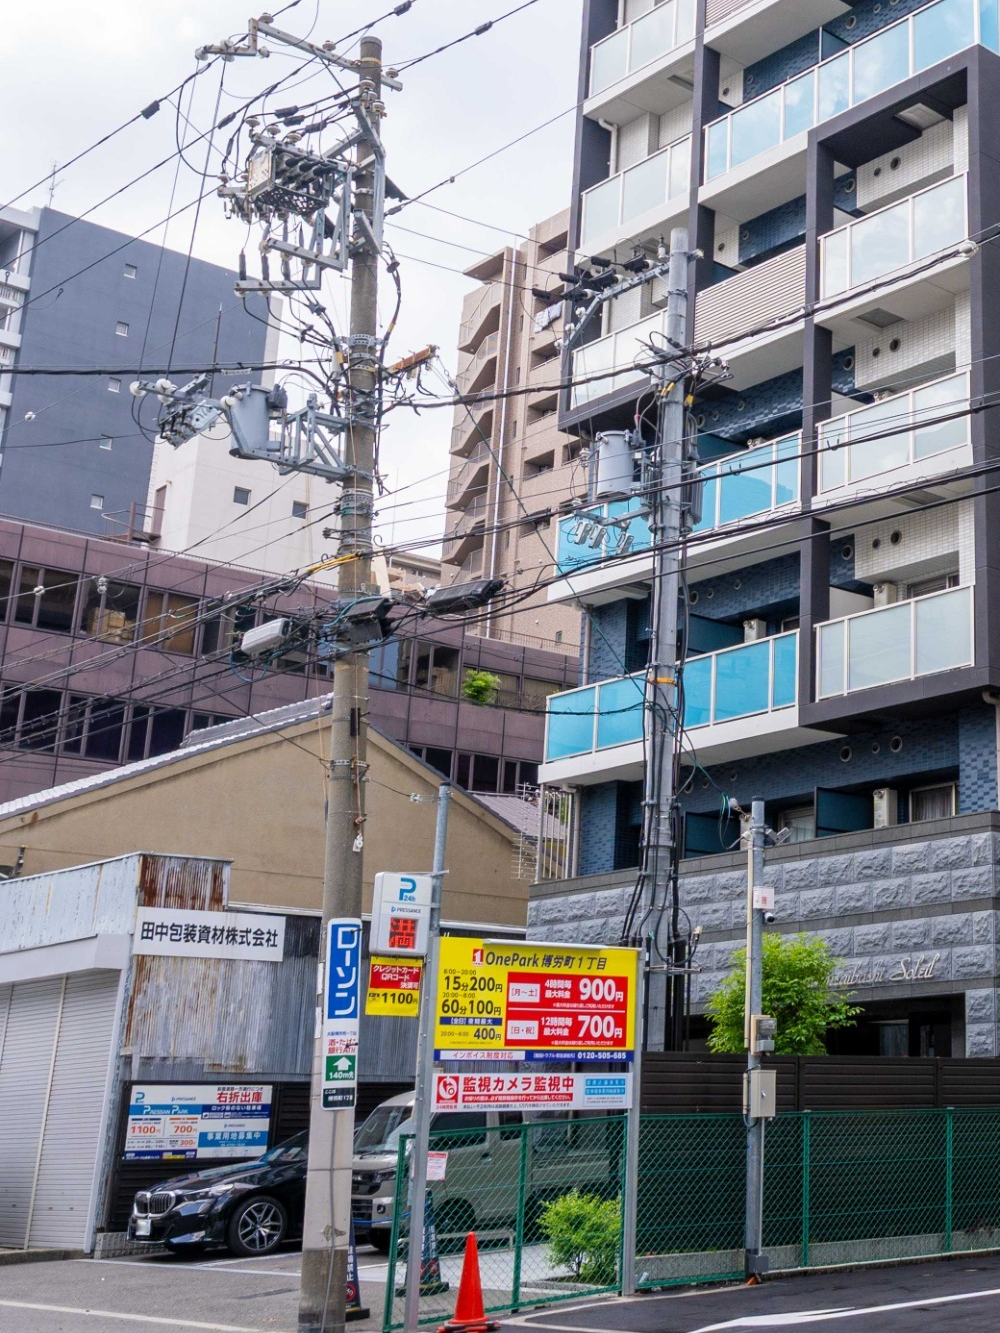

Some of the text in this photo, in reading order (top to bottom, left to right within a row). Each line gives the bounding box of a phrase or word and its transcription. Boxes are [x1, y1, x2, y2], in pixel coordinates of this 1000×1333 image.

[403, 894, 416, 902] 24h
[140, 921, 279, 948] 田中包装資材株式会社
[388, 917, 416, 949] 満
[485, 951, 539, 968] OnePark
[334, 927, 358, 1016] ローソン
[372, 965, 419, 975] クレジットカード
[889, 953, 940, 981] Soleil
[381, 973, 410, 982] QRコード
[544, 979, 572, 989] 4時間毎
[544, 990, 571, 999] 最大料金
[579, 978, 624, 1002] 900円
[541, 1016, 573, 1027] 12時間毎
[577, 1015, 623, 1039] 700円
[473, 1027, 502, 1041] 400円
[543, 1027, 570, 1037] 最大料金
[453, 1050, 514, 1060] インボイス制度対応
[577, 1051, 627, 1060] 0120-505-685
[328, 1071, 354, 1080] 140m先
[462, 1076, 575, 1093] 監視カメラ監視中
[217, 1092, 263, 1103] 右折出庫
